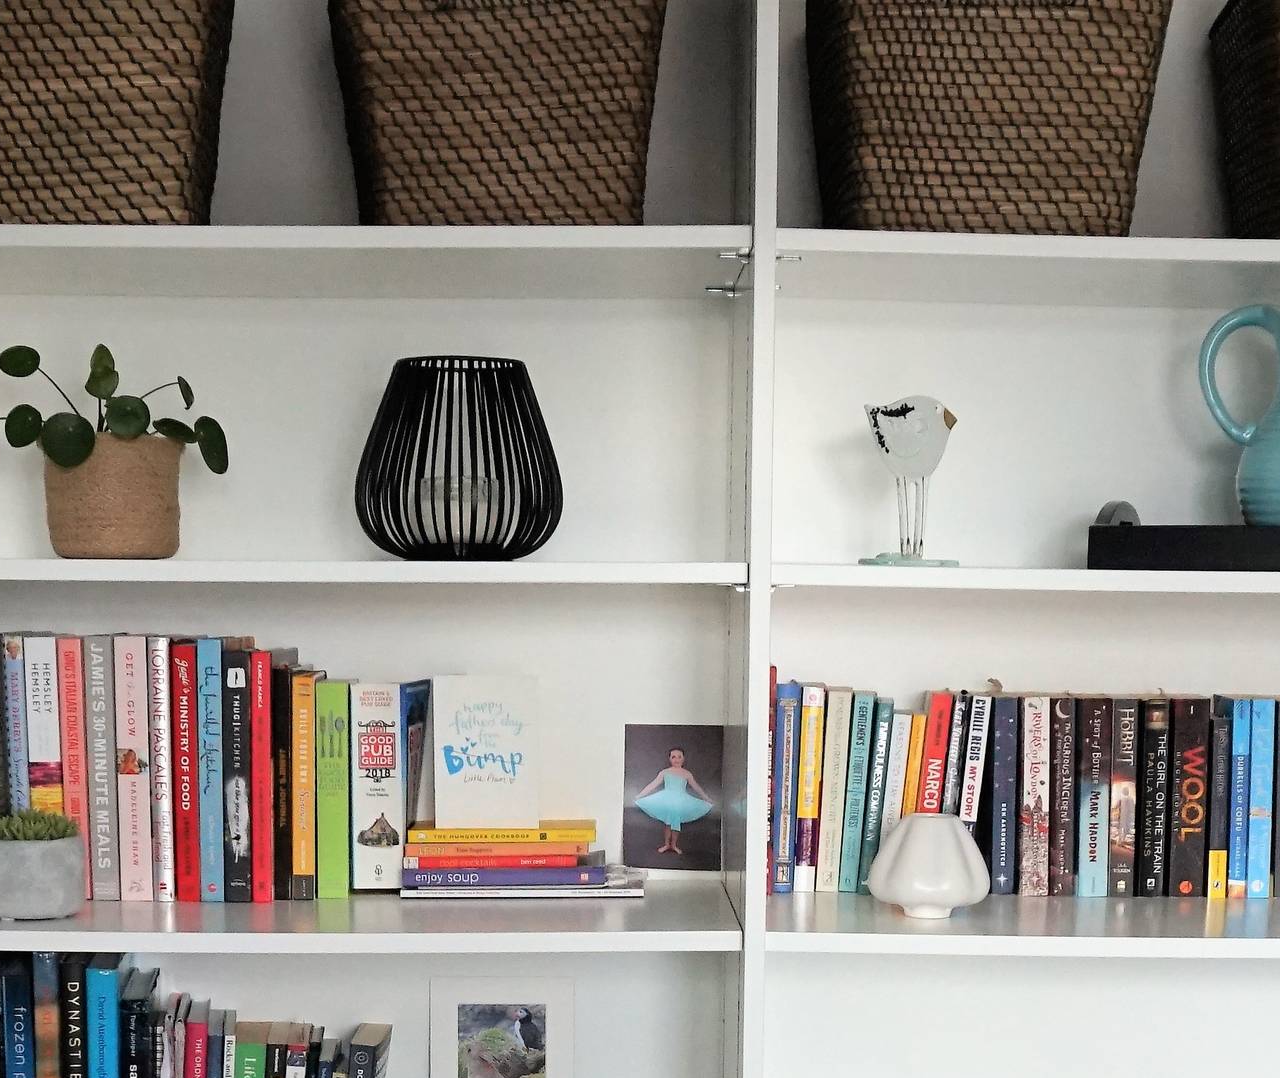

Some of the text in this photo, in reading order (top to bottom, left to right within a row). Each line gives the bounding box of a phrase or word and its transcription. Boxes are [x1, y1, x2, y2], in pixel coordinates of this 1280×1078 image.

[30, 662, 40, 714] HEMSLEY
[42, 662, 52, 714] HEMSLEY
[126, 700, 137, 738] GLOW
[151, 647, 167, 801] LORRAINE PASCALE'S
[179, 694, 190, 753] MINISTRY
[233, 695, 242, 769] THUG KITCHEN
[360, 736, 394, 744] GOOD
[67, 754, 80, 785] ESCAPE
[90, 642, 111, 870] JAMIE'S 30-MINUTE MEALS
[181, 756, 190, 772] OF
[361, 745, 393, 756] PUB
[361, 757, 393, 765] GUIDE
[871, 726, 888, 788] MINDFULNESS
[964, 699, 987, 818] CYRILLE REGIS MY STORY
[181, 775, 191, 811] FOOD
[365, 768, 391, 778] 2018
[923, 758, 943, 809] NARCO
[1178, 745, 1207, 843] WOOL
[1236, 756, 1244, 793] DURRELLS
[1144, 752, 1155, 857] PAULA HAWKINS
[1153, 733, 1168, 874] THE GIRL ON THE TRAIN
[1234, 806, 1243, 832] CORFU
[1088, 790, 1100, 863] MARK HADDON
[415, 871, 479, 884] enjoy soup
[14, 1005, 28, 1066] frozen
[194, 1038, 203, 1055] THE
[225, 1039, 234, 1062] Rocks
[225, 1063, 233, 1078] and
